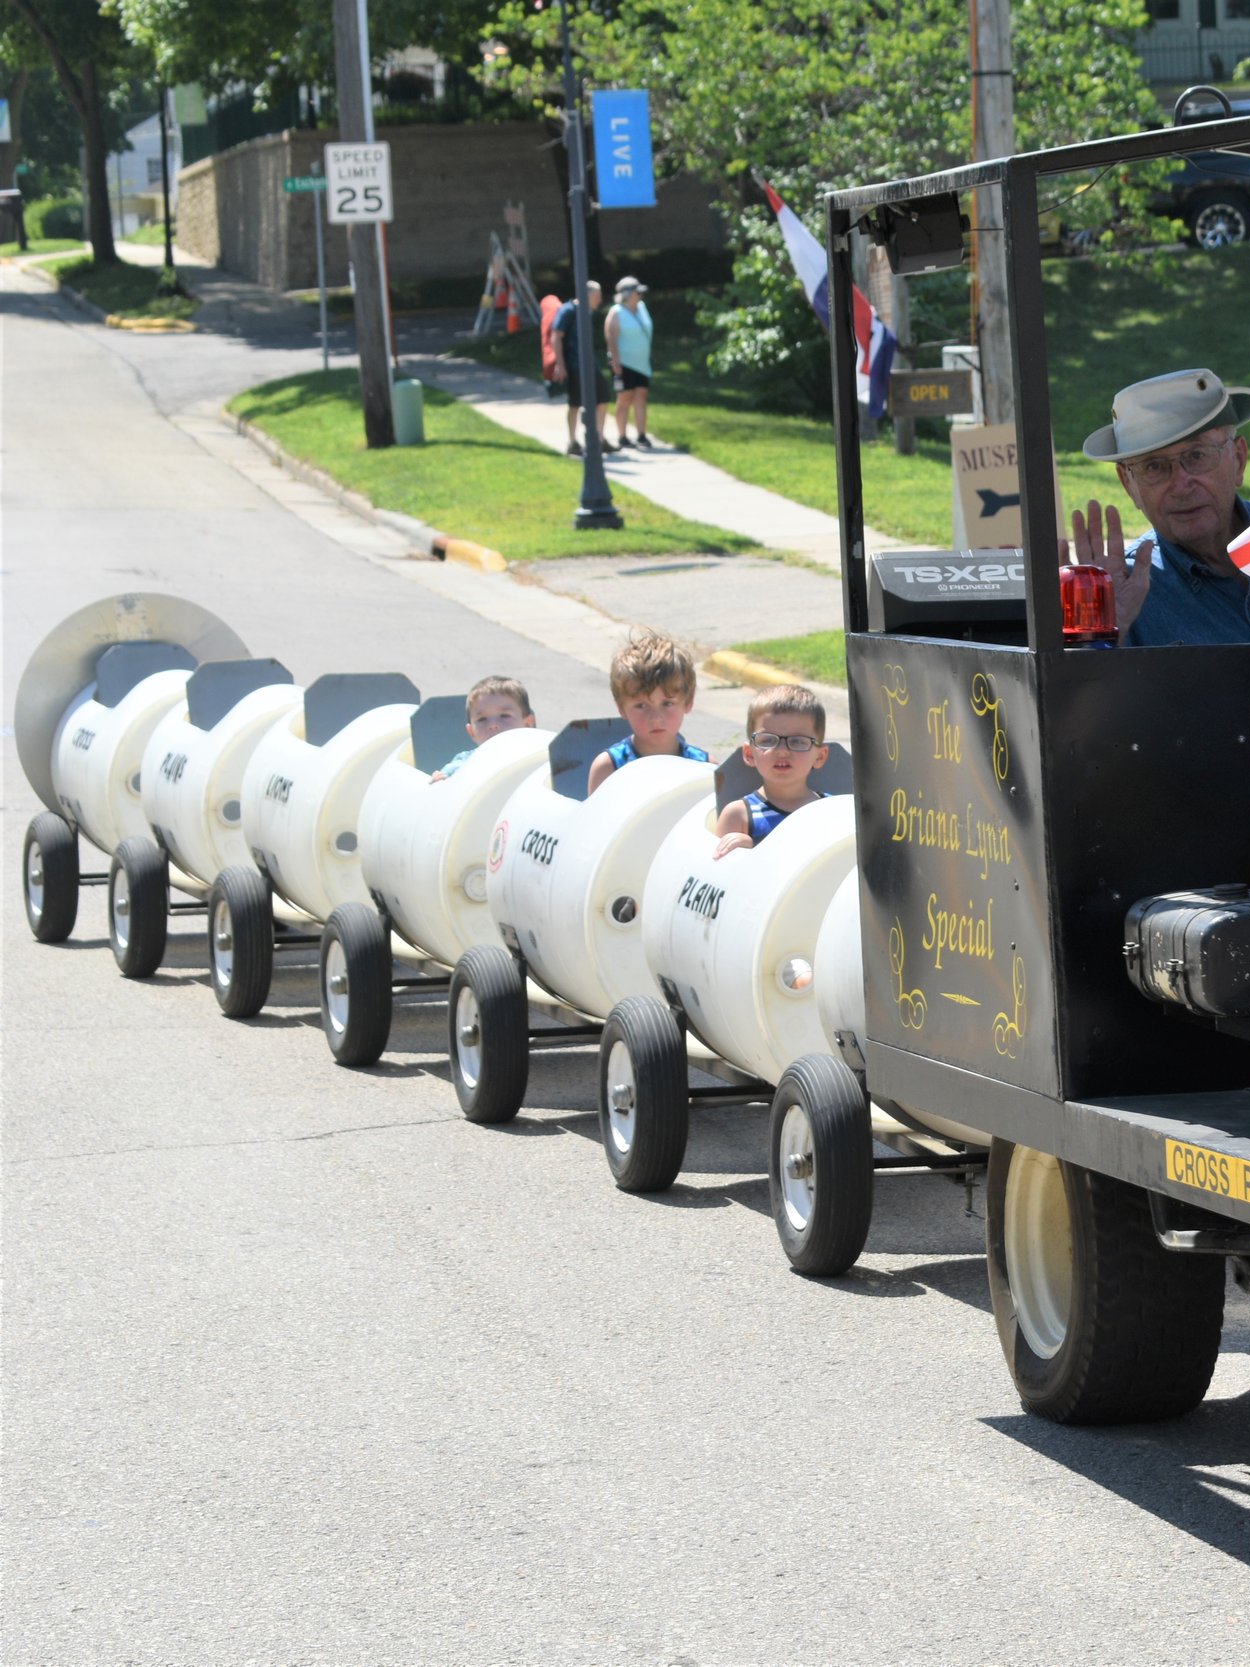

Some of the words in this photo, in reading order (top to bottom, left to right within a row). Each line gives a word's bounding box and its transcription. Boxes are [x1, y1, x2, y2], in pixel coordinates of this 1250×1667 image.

[332, 149, 383, 162] SPEED
[610, 117, 633, 179] LIVE
[338, 166, 377, 178] LIMIT
[337, 186, 383, 213] 25
[910, 384, 949, 402] OPEN
[960, 443, 1018, 473] MUSE
[926, 699, 962, 764] The
[521, 828, 559, 866] CROSS
[889, 786, 961, 852] Briana
[965, 802, 1012, 880] Lynn
[678, 875, 726, 919] PLAINS
[921, 892, 995, 970] Special
[1173, 1145, 1230, 1196] CROSS
